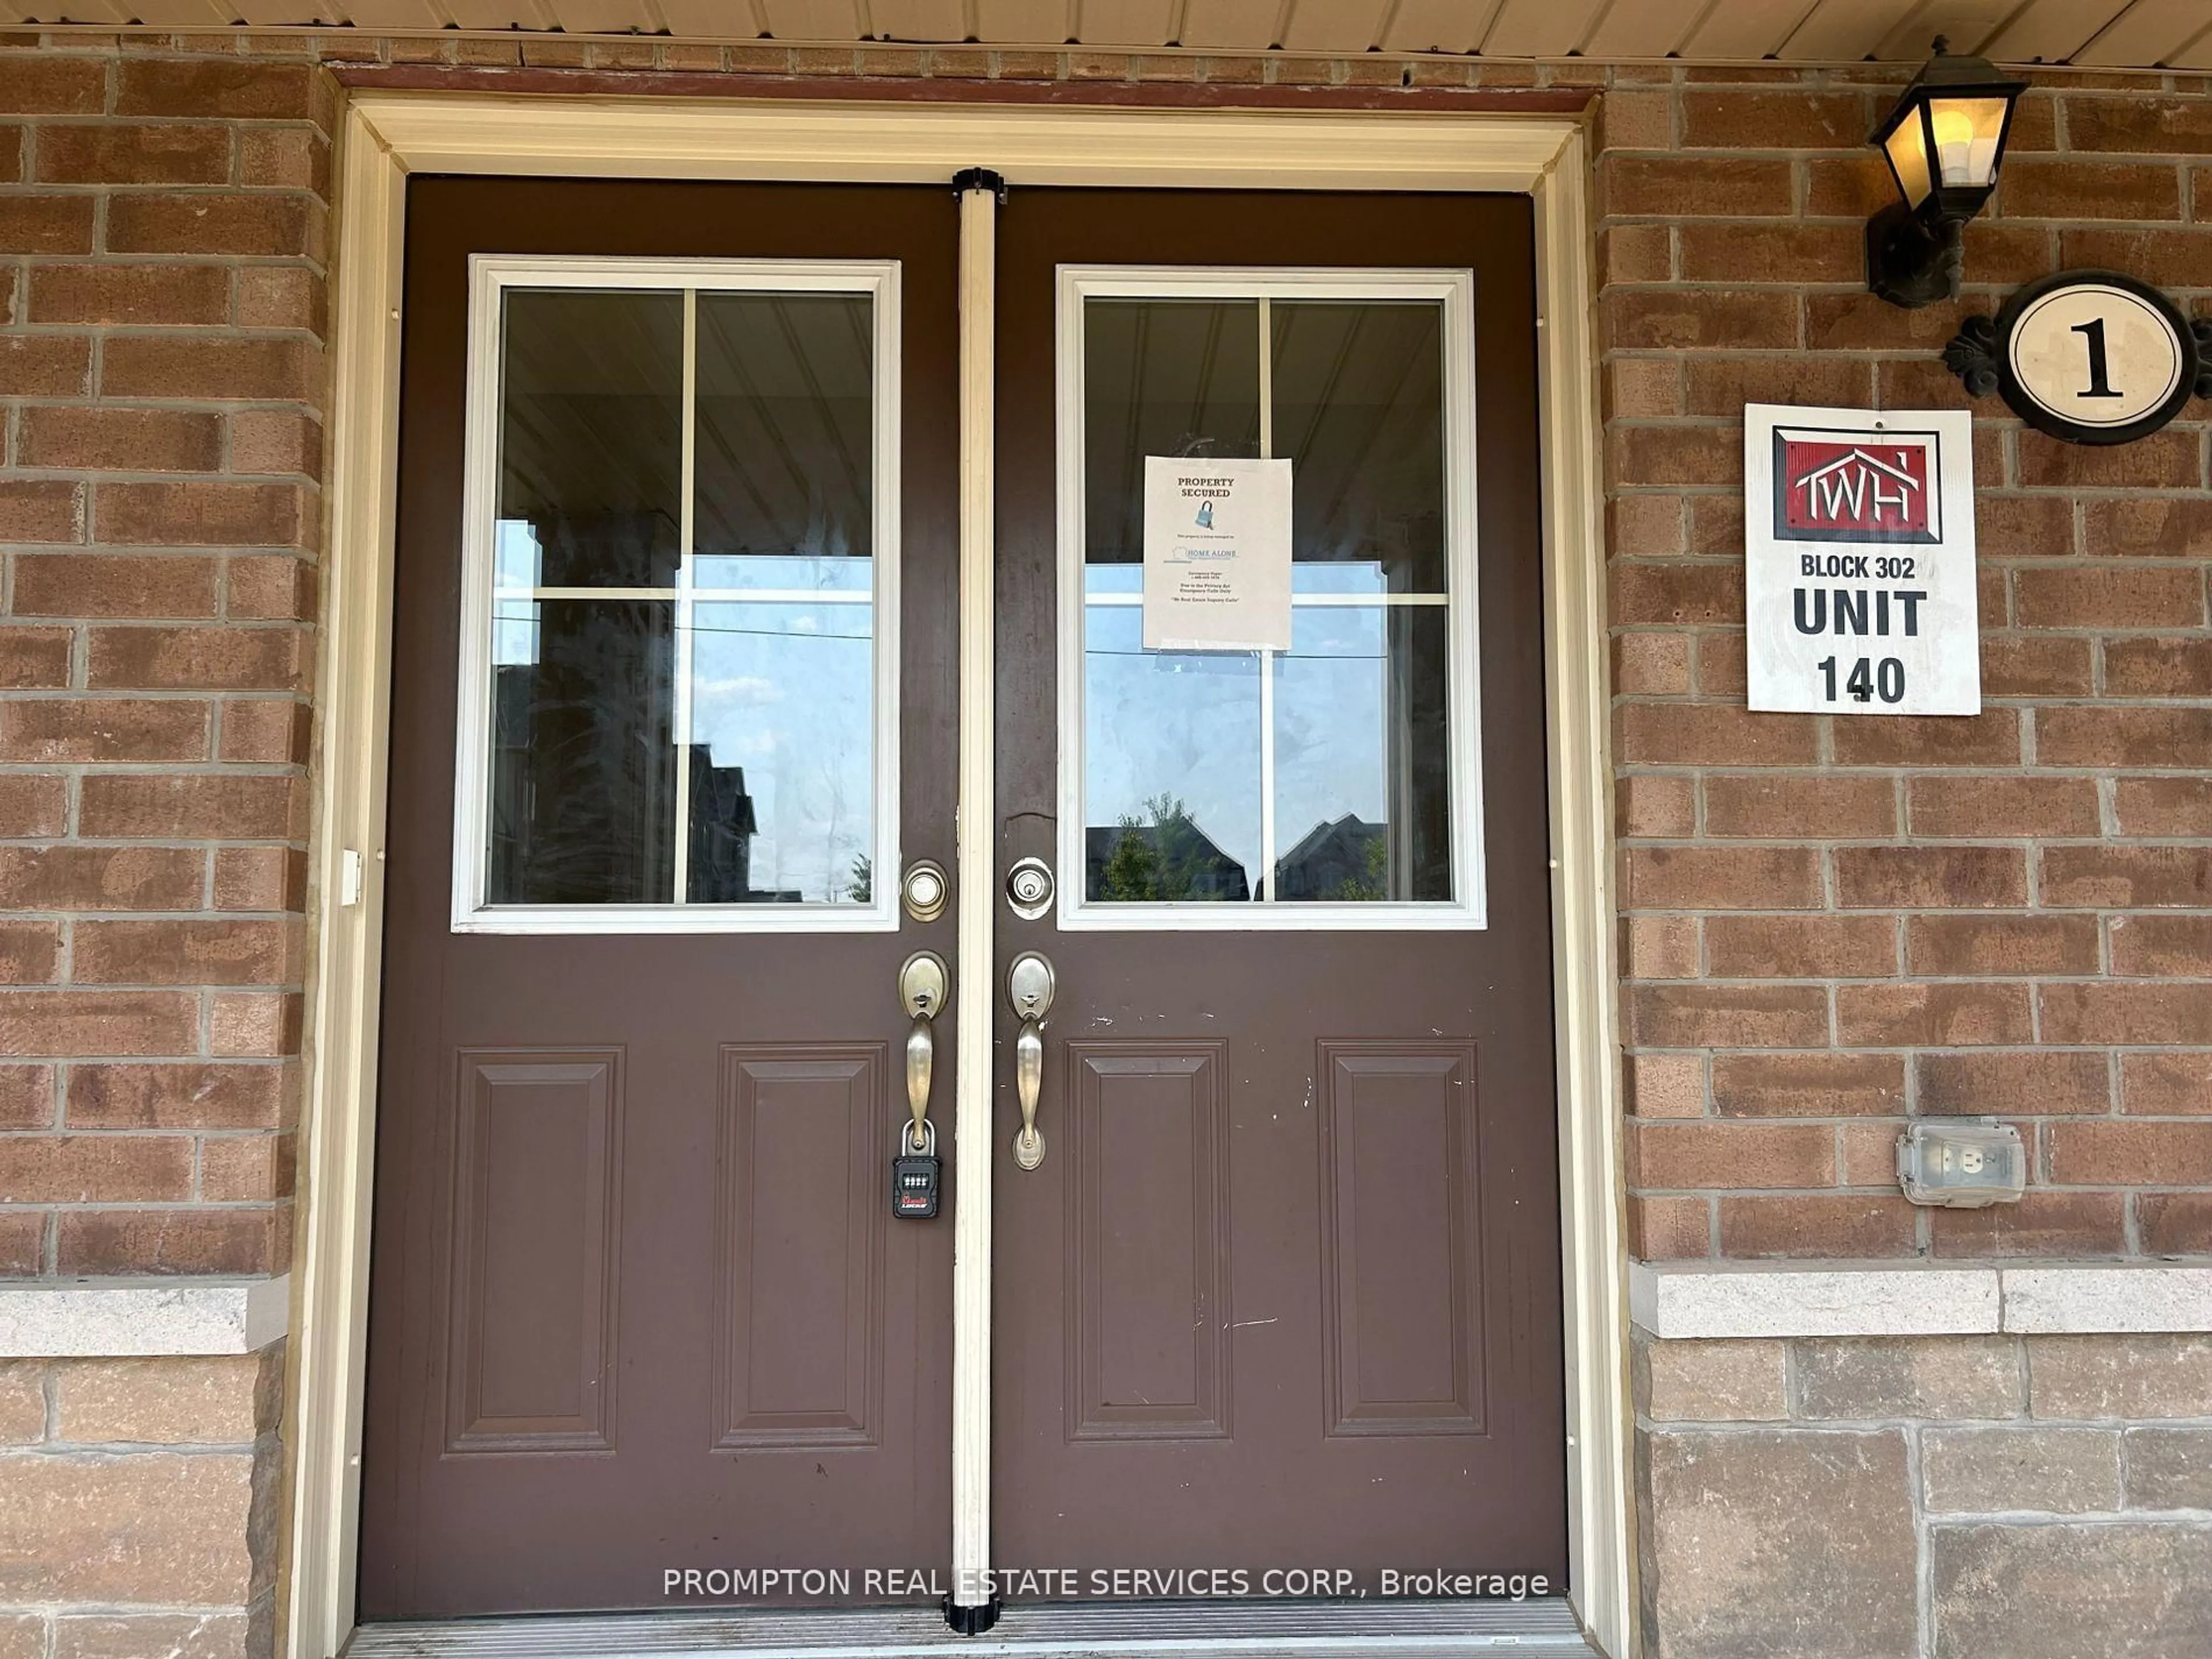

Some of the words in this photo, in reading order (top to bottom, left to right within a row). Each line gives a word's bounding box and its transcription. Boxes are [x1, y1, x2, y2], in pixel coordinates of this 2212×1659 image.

[2070, 317, 2124, 397] 1
[1177, 478, 1234, 486] PROPERTY
[1181, 488, 1230, 497] SECURED
[1795, 447, 1919, 522] TWH
[1801, 555, 1869, 578] BLOCK
[1876, 557, 1915, 579] 302
[1793, 588, 1927, 636] UNIT
[1818, 656, 1906, 703] 140
